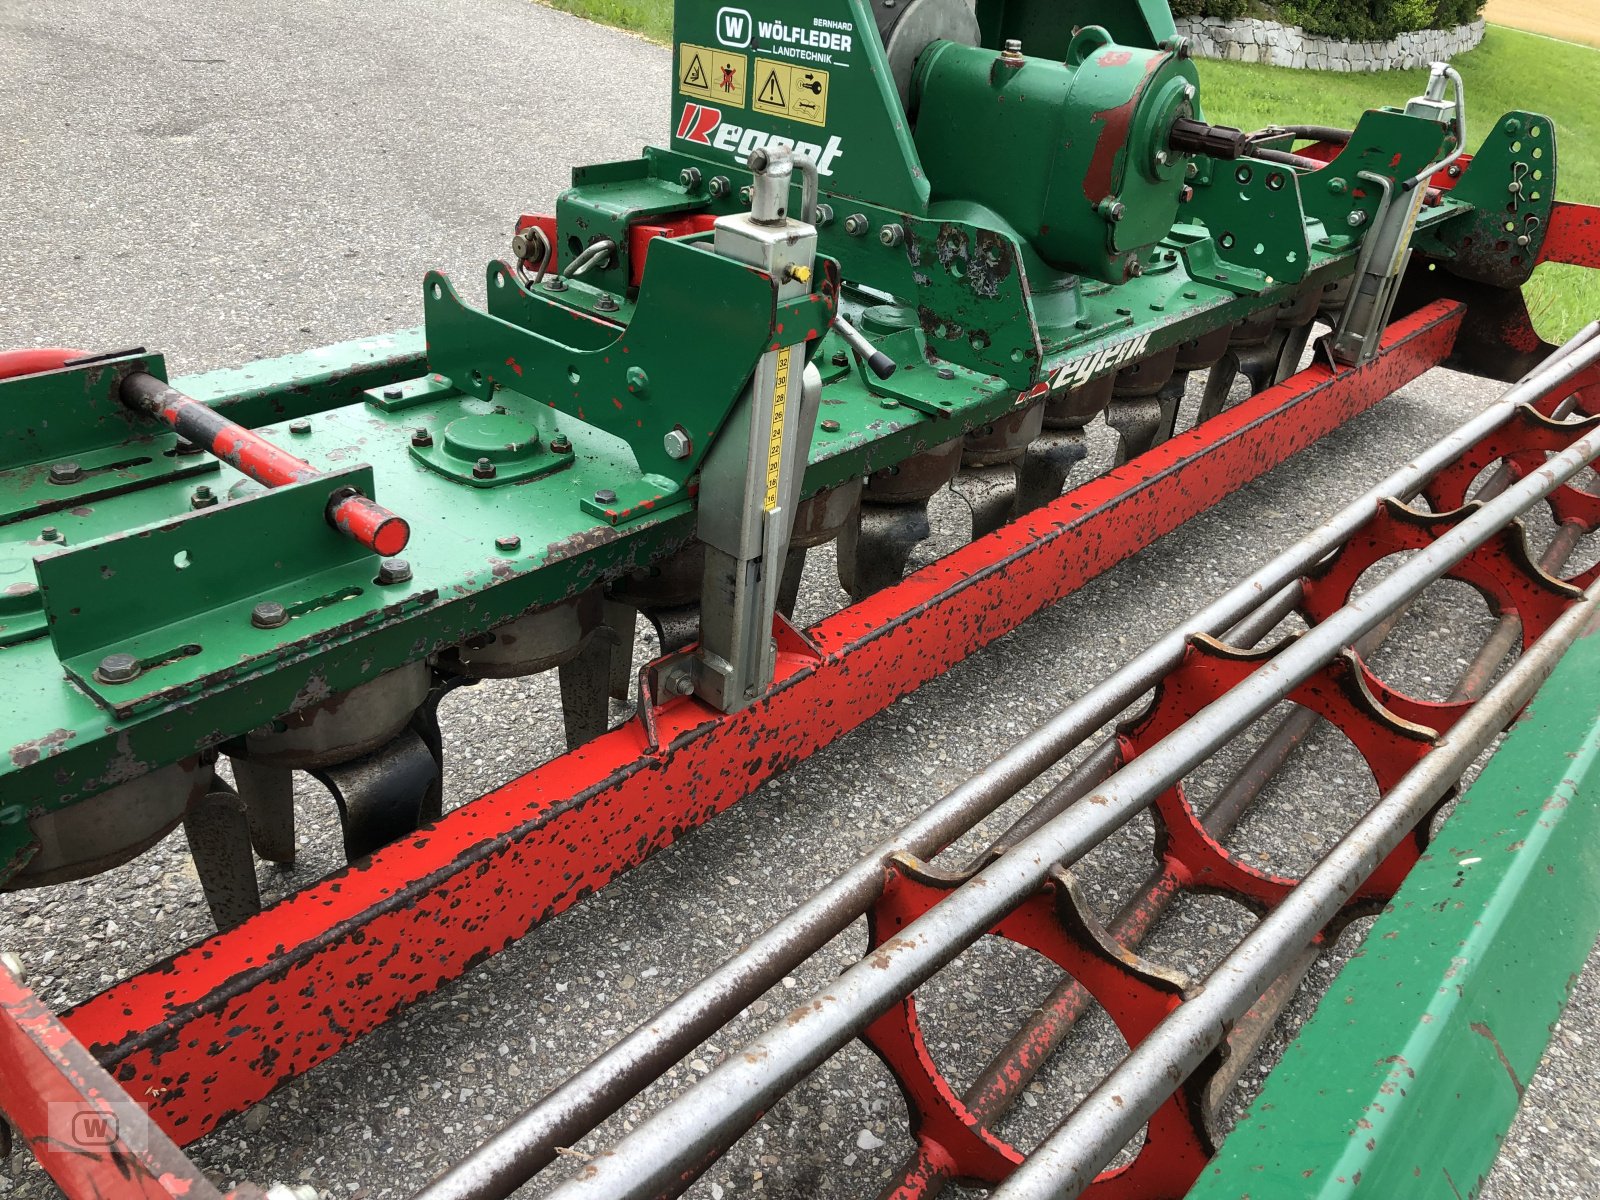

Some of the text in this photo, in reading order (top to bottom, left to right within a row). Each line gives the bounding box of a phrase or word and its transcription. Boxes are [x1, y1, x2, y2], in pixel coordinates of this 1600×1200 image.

[725, 16, 743, 39] W
[813, 17, 852, 31] BERNHARD
[758, 20, 852, 52] WÖLFLEDER
[772, 45, 832, 64] LANDTECHNIK
[779, 358, 788, 367] 32
[777, 375, 786, 385] 30
[775, 394, 784, 403] 28
[774, 412, 783, 421] 26
[772, 429, 781, 438] 24
[771, 445, 780, 454] 22
[769, 462, 778, 471] 20
[768, 479, 777, 488] 18
[767, 494, 775, 503] 16
